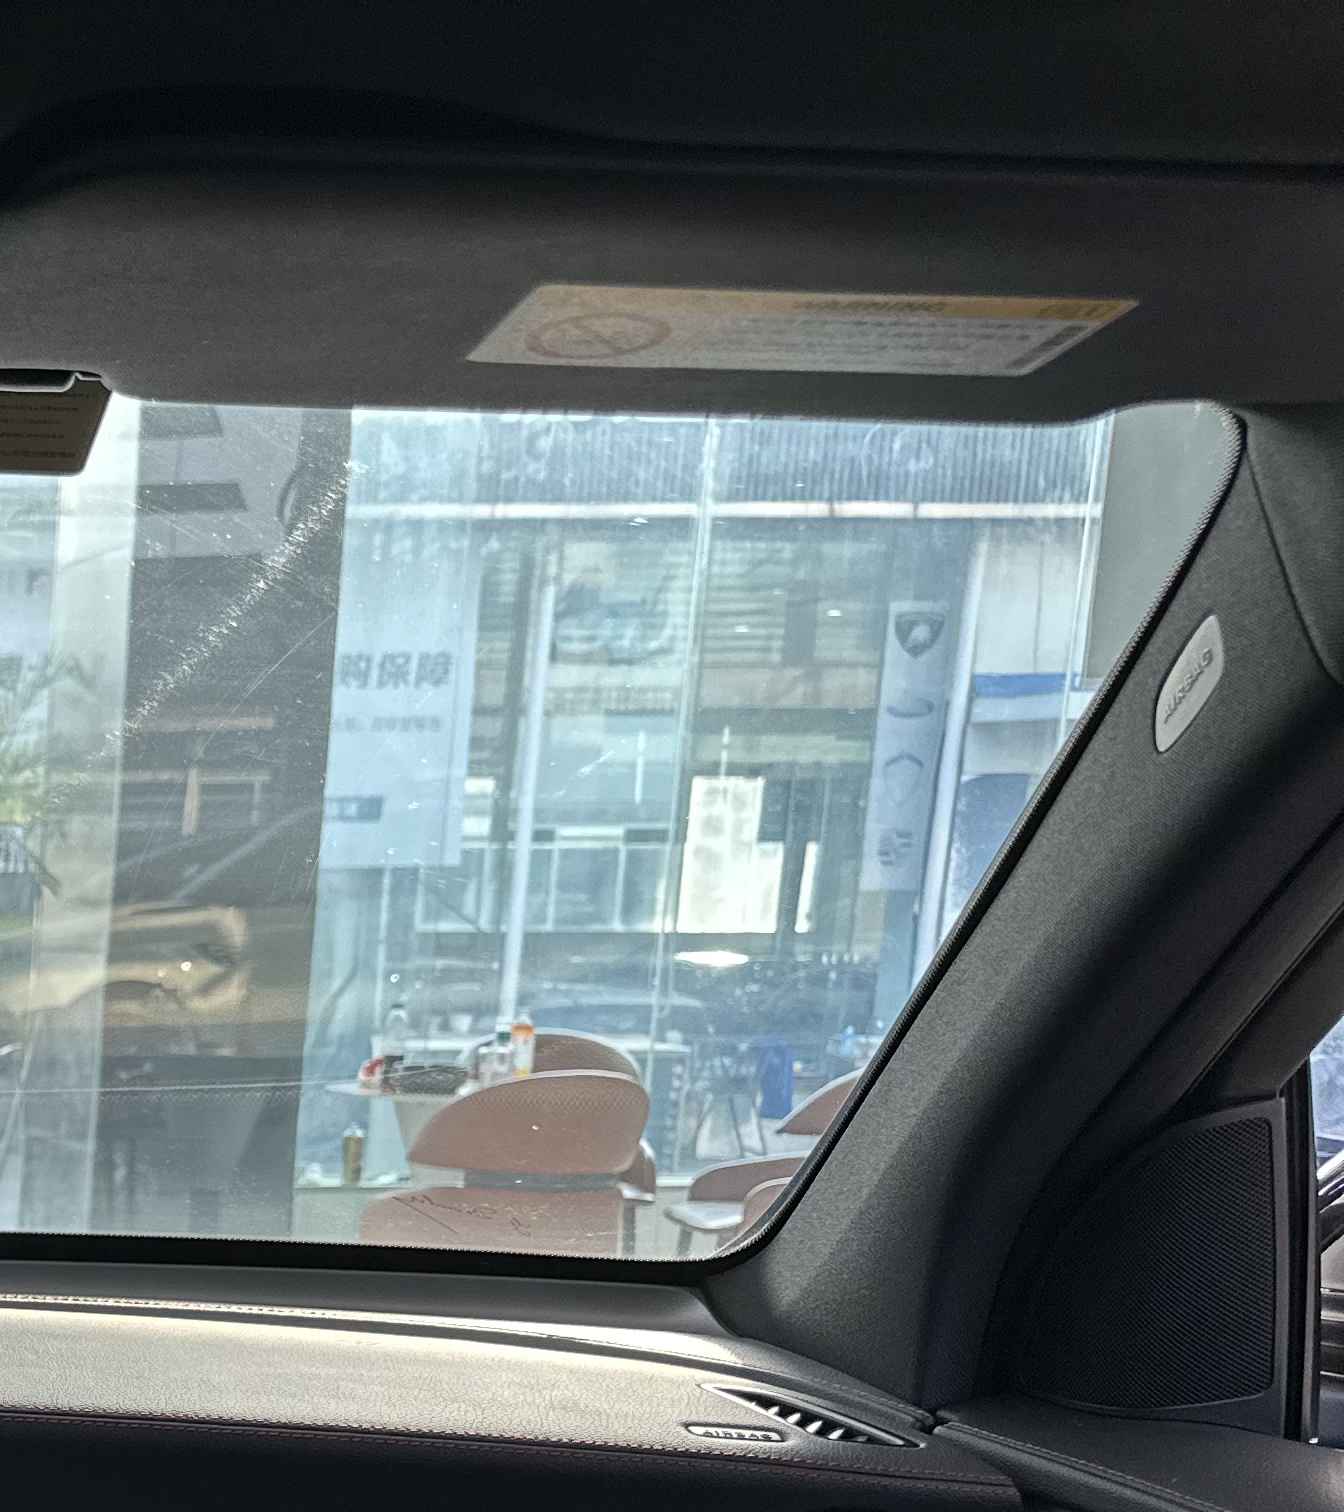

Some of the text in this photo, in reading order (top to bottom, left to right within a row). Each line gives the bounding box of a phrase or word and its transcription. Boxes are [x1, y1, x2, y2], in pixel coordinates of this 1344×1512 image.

[339, 651, 452, 690] 购保障
[1163, 647, 1213, 724] AIRBAG
[703, 1429, 772, 1441] AIRBAG
